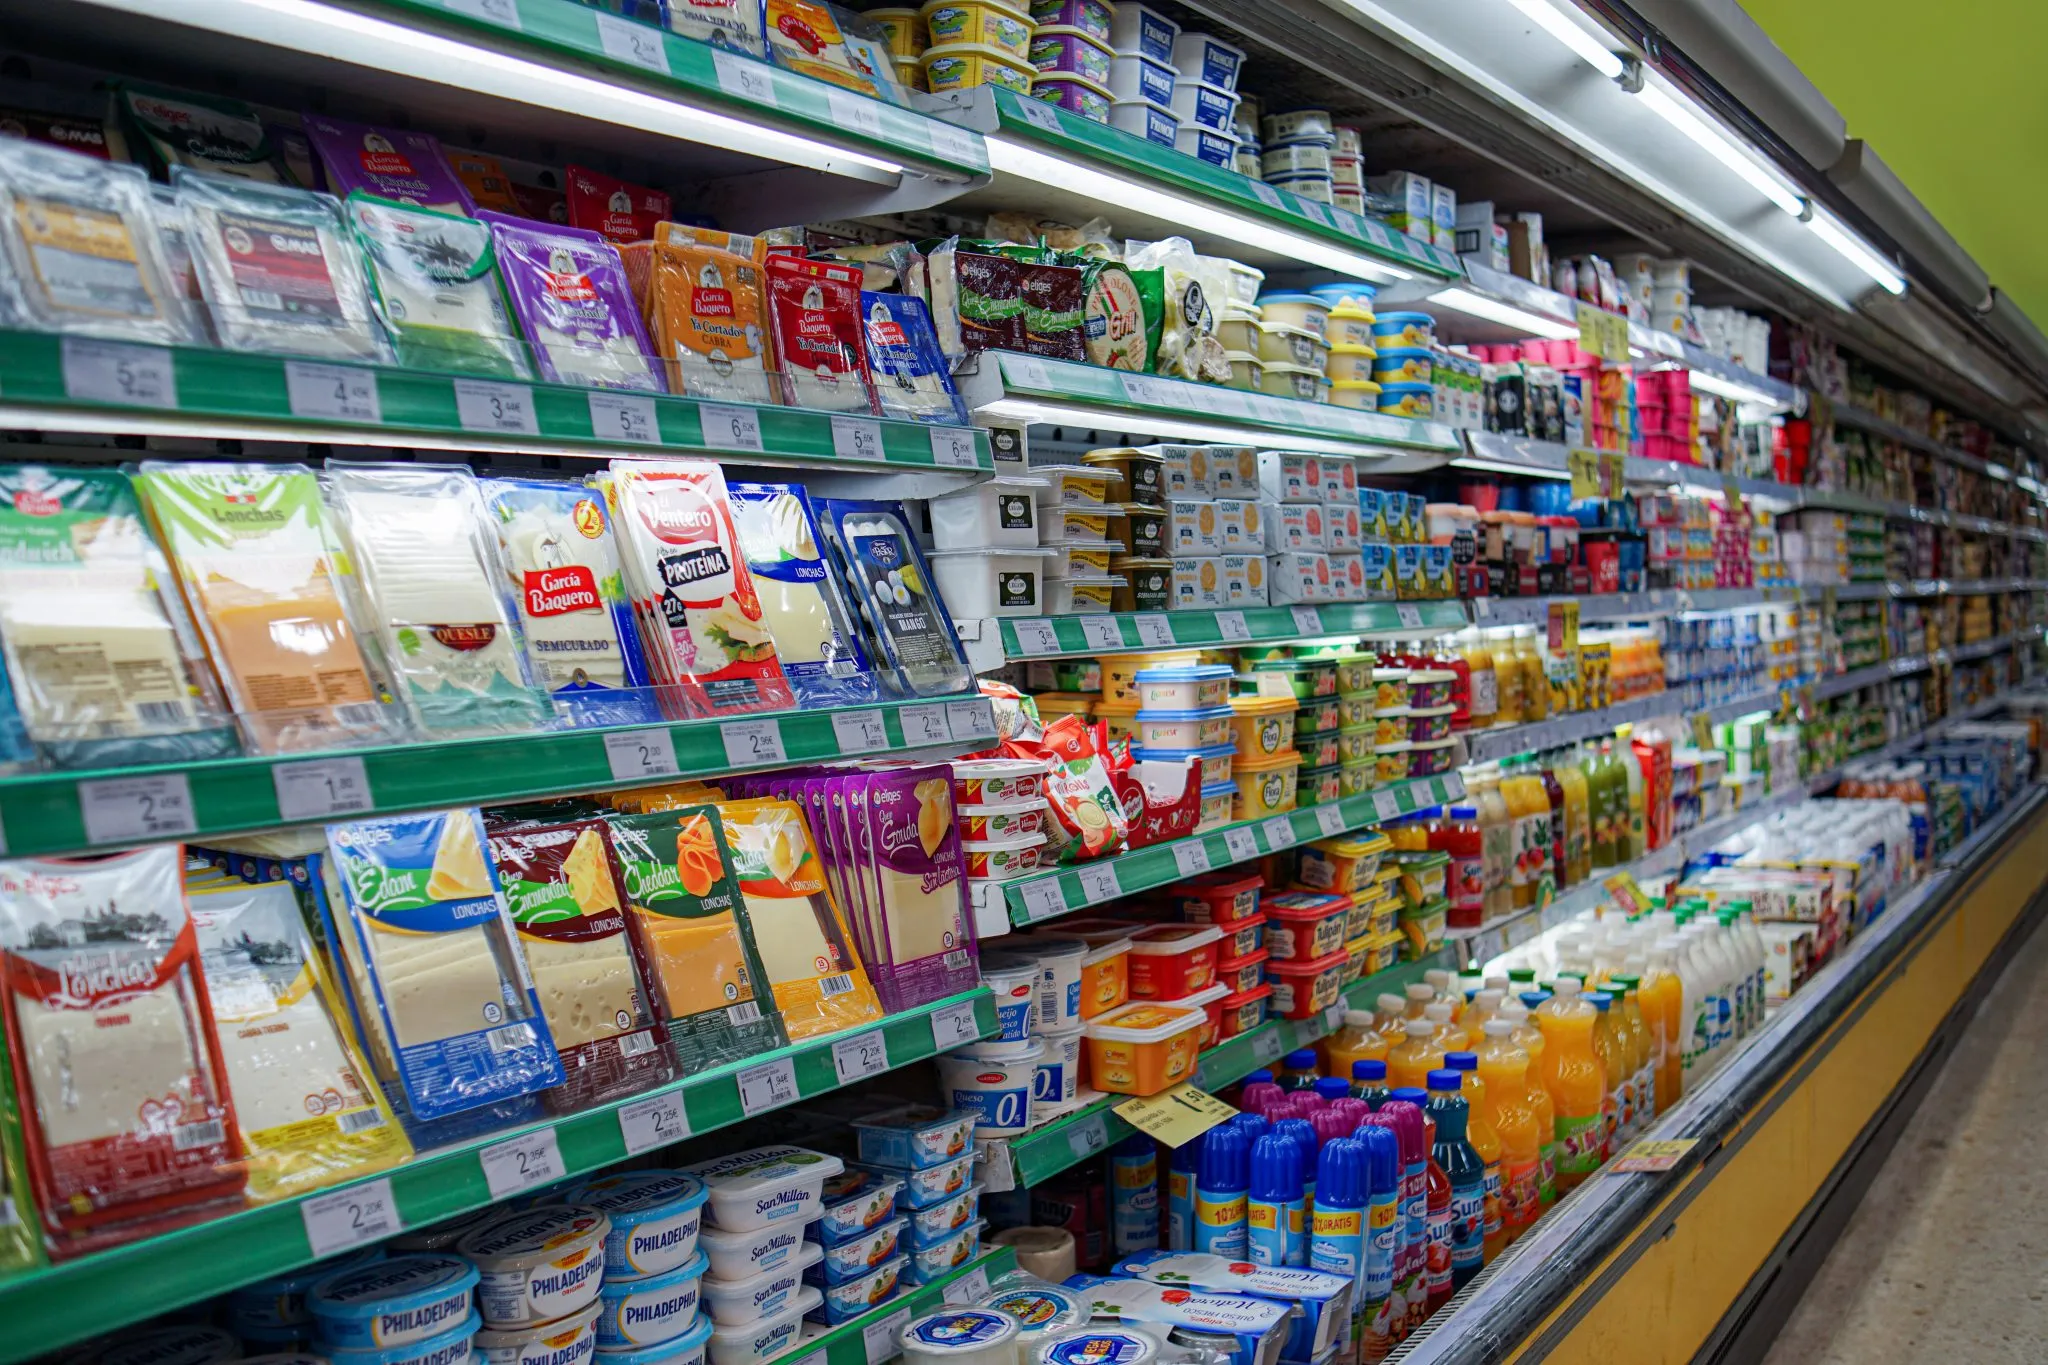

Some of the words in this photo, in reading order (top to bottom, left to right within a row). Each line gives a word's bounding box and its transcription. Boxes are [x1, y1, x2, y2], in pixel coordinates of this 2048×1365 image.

[1144, 23, 1171, 47] PRIMOR
[1208, 48, 1235, 69] PRIMOR
[1143, 69, 1171, 93] PRIMOR
[1200, 90, 1229, 110] PRIMOR
[1150, 116, 1174, 140] PRIMOR
[1202, 134, 1231, 153] PRIMOR
[610, 212, 632, 226] García
[603, 219, 638, 236] Baquero
[969, 265, 991, 278] eliges
[1030, 280, 1052, 293] eliges
[701, 289, 724, 303] García
[695, 300, 731, 316] Baquero
[804, 311, 825, 323] García
[799, 319, 831, 336] Baquero
[1109, 312, 1137, 341] Grill
[701, 333, 733, 349] CABRA
[1166, 449, 1187, 460] COVAP
[1213, 449, 1234, 459] COVAP
[1283, 458, 1303, 467] COVAP
[1323, 461, 1340, 471] COVAP
[212, 507, 285, 523] Lonchas
[1175, 503, 1196, 514] COVAP
[1221, 502, 1240, 512] COVAP
[1282, 507, 1302, 517] COVAP
[1329, 509, 1344, 518] COVAP
[643, 501, 712, 530] Ventero
[665, 549, 725, 586] PROTEÍNA
[1175, 560, 1197, 572] COVAP
[1225, 559, 1244, 569] COVAP
[1297, 556, 1313, 567] COVAP
[1330, 559, 1346, 569] COVAP
[795, 566, 825, 578] LONCHAS
[540, 571, 581, 593] García
[529, 589, 594, 613] Baquero
[898, 616, 927, 632] MANGO
[535, 638, 609, 653] SEMICURADO
[1263, 731, 1279, 743] Flora
[881, 789, 901, 805] eliges
[1265, 785, 1280, 797] Flora
[351, 826, 393, 847] eliges
[880, 813, 919, 850] Gouda
[500, 845, 535, 862] eliges
[933, 850, 957, 865] LONCHAS
[500, 869, 523, 885] Queso
[624, 856, 681, 900] Cheddar
[921, 871, 938, 893] Sin
[357, 864, 418, 908] Edam
[507, 864, 575, 918] Emmental
[789, 878, 823, 893] LONCHAS
[451, 898, 498, 920] LONCHAS
[700, 894, 733, 912] LONCHAS
[589, 915, 625, 934] LONCHAS
[1316, 919, 1343, 940] Tulipán
[1315, 974, 1338, 995] Tulipán
[998, 1007, 1018, 1020] ueijo
[999, 1020, 1019, 1032] resco
[1002, 1028, 1021, 1039] atido
[955, 1090, 984, 1104] Queso
[597, 1176, 690, 1210] HILADELPHIA
[769, 1204, 798, 1219] ORIGINAL
[835, 1218, 856, 1233] Natural
[1323, 1215, 1353, 1231] GRATIS
[633, 1217, 699, 1256] PHILADELPHIA
[840, 1257, 861, 1273] Natural
[531, 1253, 602, 1299] PHILADELPHIA
[1243, 1267, 1320, 1282] Natural
[625, 1289, 697, 1326] PHILADELPHIA
[841, 1295, 862, 1310] Natural
[1176, 1297, 1257, 1310] Natural
[381, 1291, 466, 1337] PHILADELPHIA
[1183, 1307, 1220, 1319] FRESCO
[1221, 1312, 1256, 1322] QUESO
